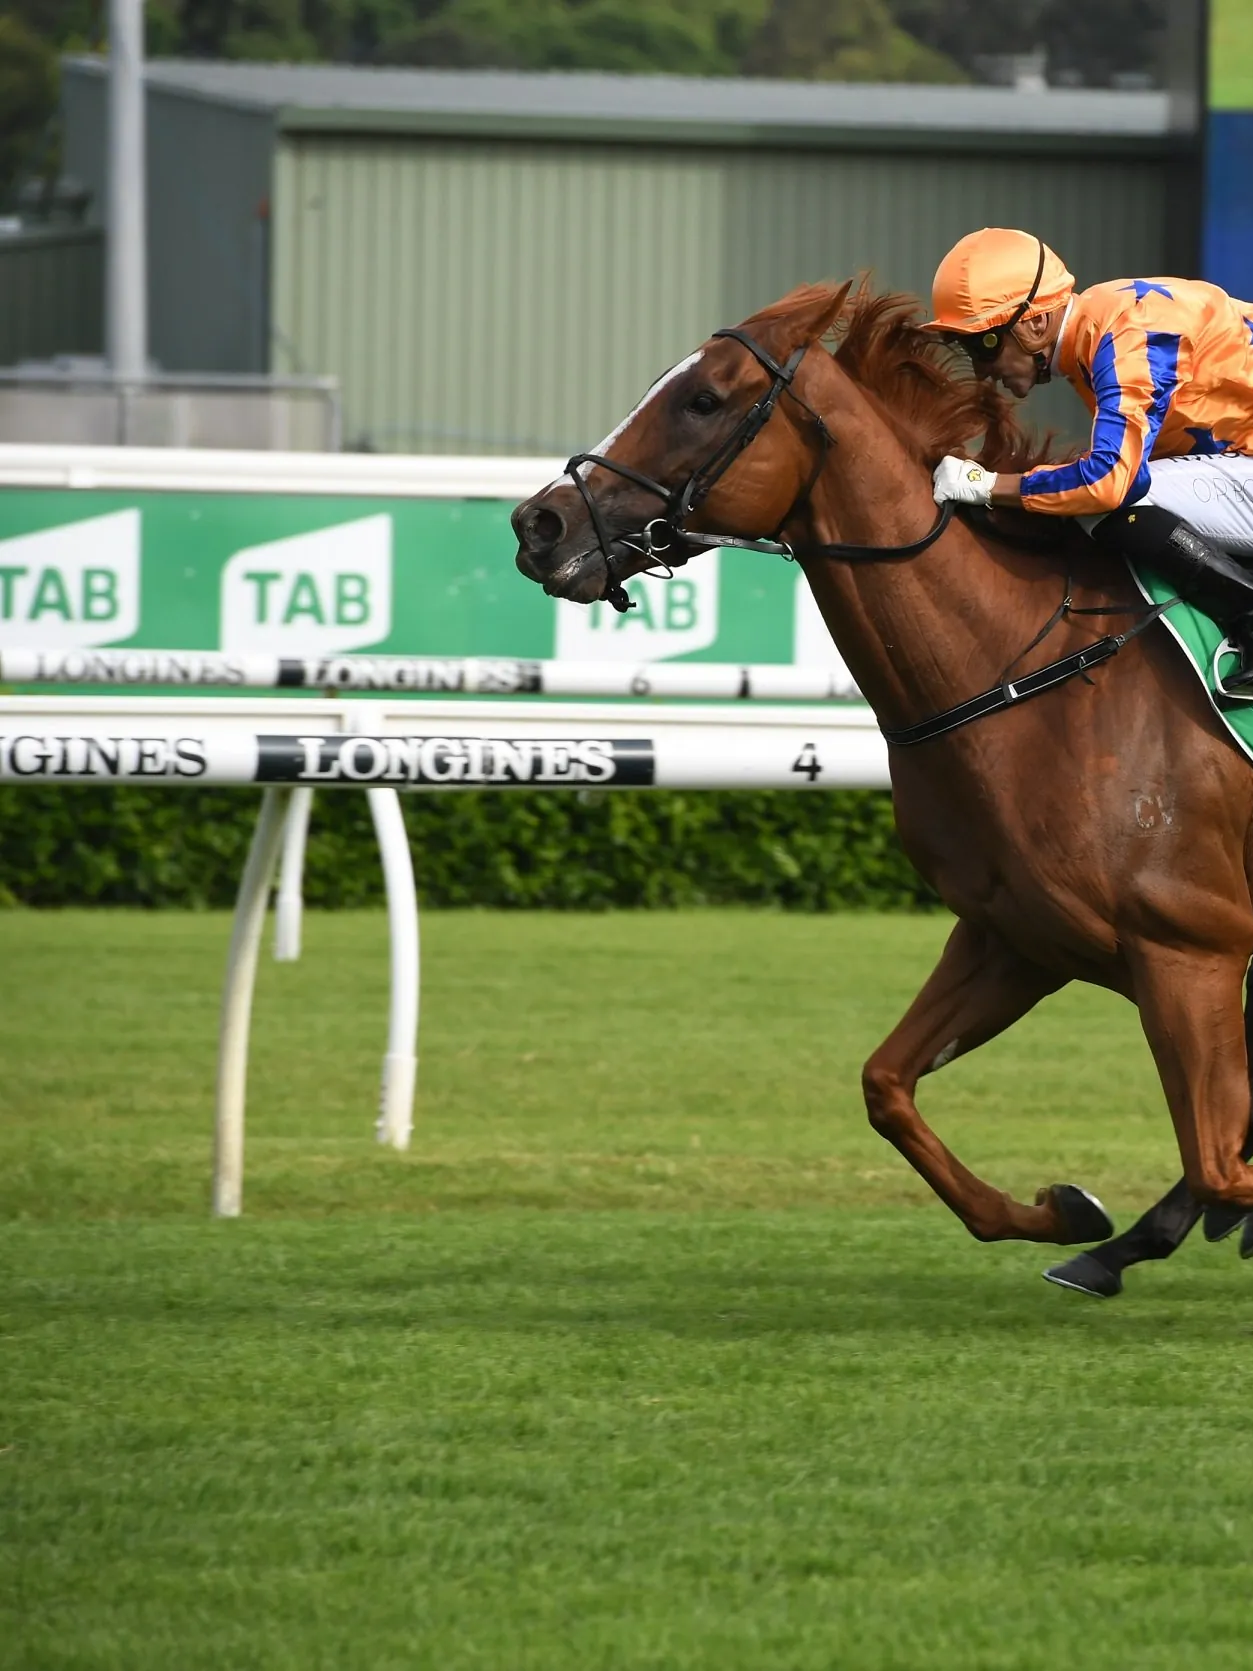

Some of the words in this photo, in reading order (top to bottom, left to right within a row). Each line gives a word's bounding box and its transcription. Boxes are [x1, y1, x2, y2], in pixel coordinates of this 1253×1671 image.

[0, 567, 118, 622] TAB
[243, 571, 371, 626] TAB
[34, 652, 247, 687] LONGINES
[0, 735, 207, 777] GINES
[297, 736, 616, 782] LONGINES
[792, 742, 823, 782] 4
